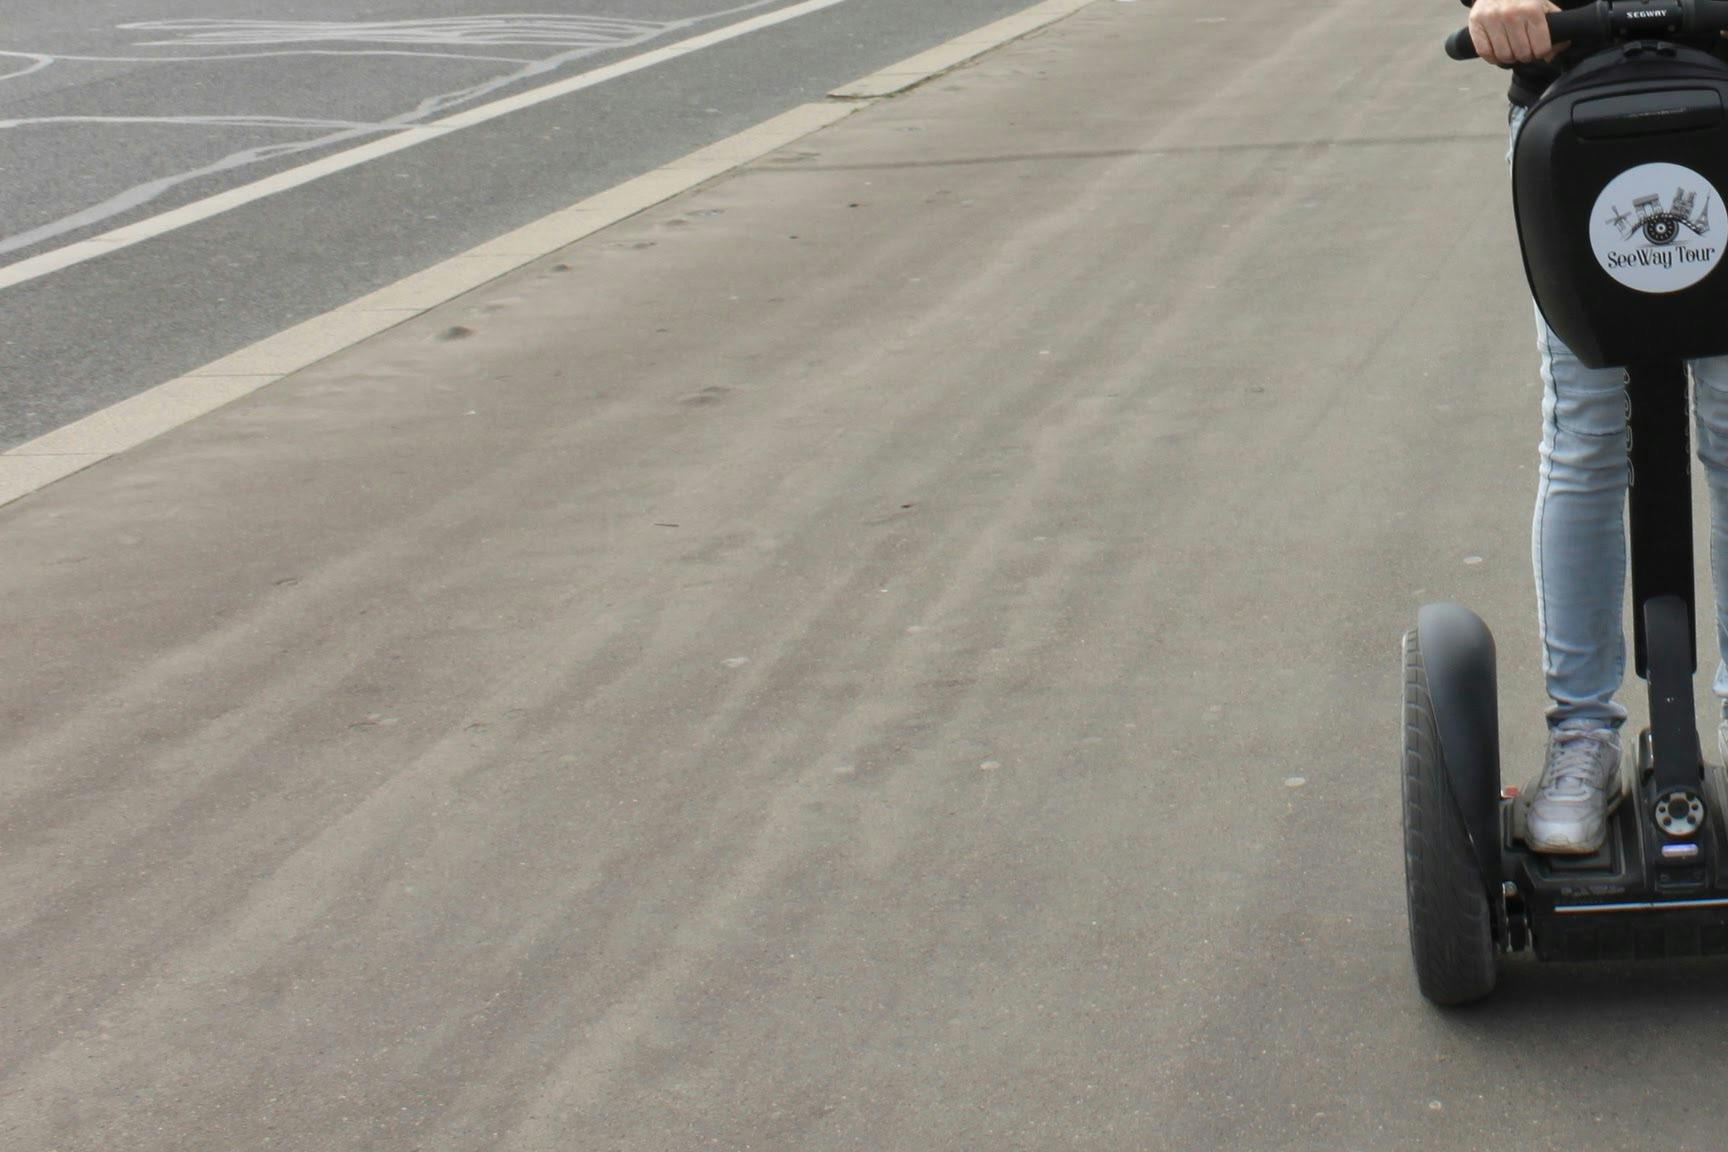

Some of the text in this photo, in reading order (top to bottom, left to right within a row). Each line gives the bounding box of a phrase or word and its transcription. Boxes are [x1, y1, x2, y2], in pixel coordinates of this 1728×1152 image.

[1626, 9, 1667, 19] SEGWAY
[1607, 246, 1715, 269] SeeWay Tour
